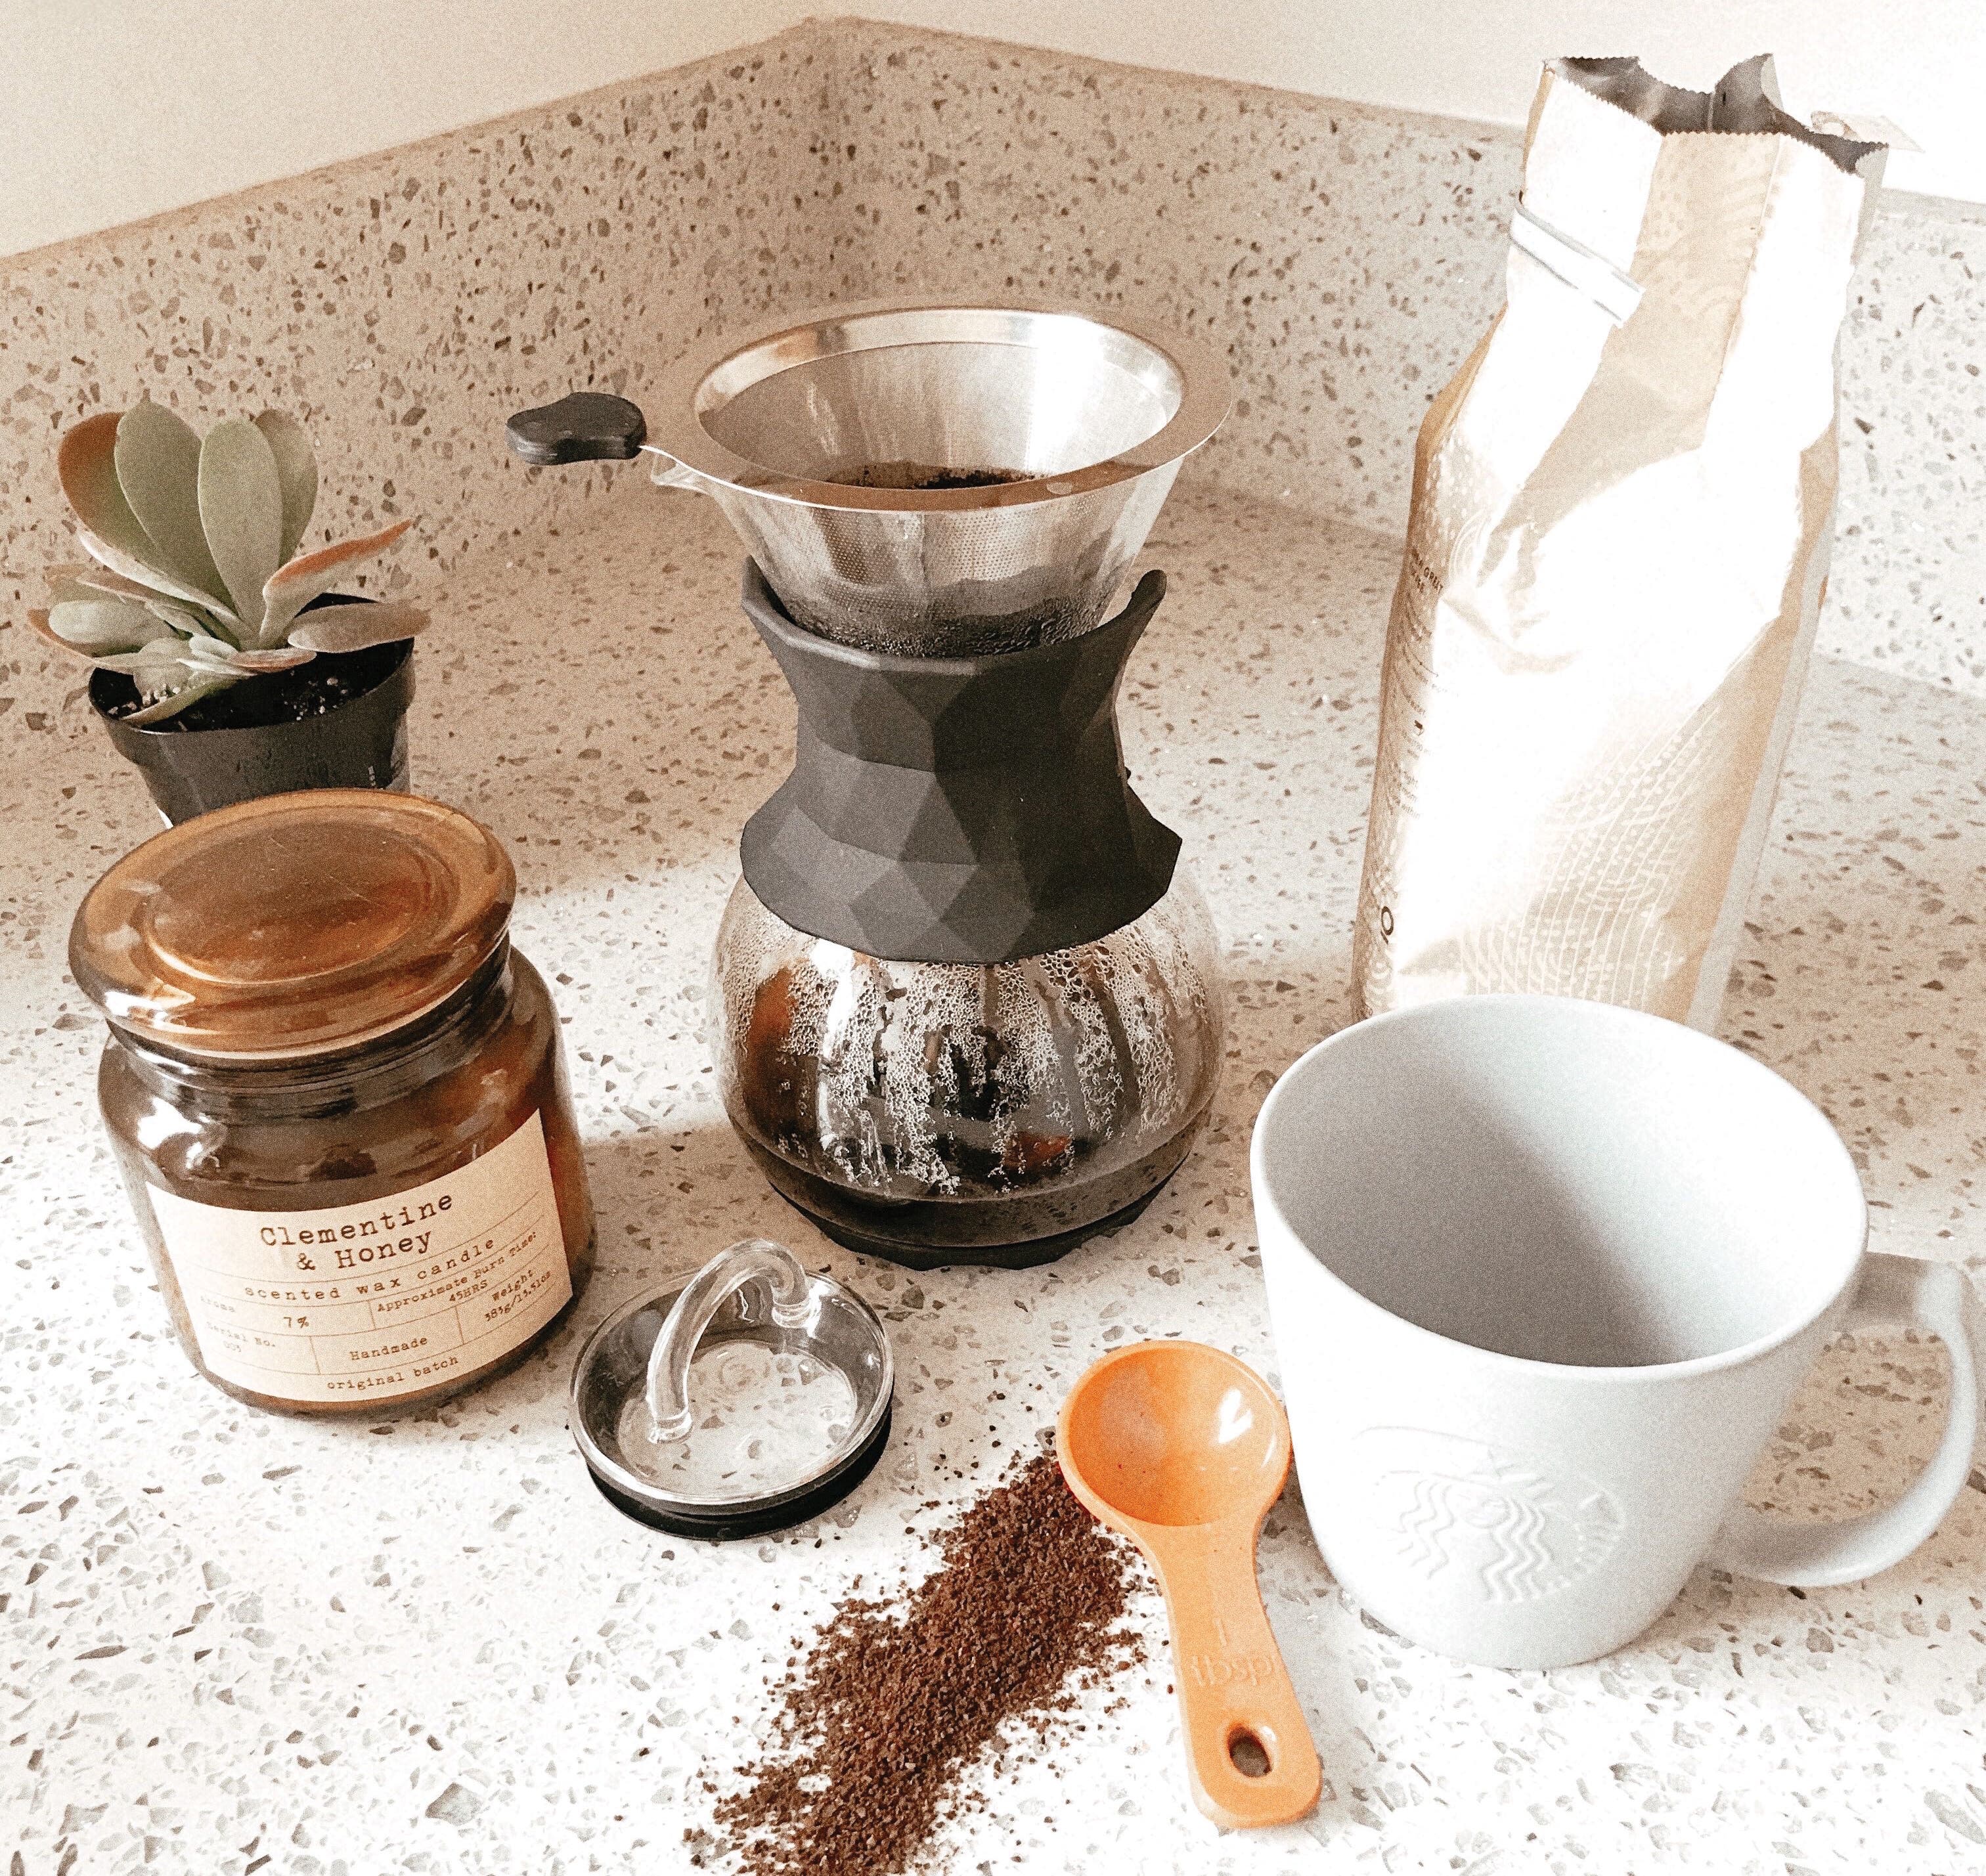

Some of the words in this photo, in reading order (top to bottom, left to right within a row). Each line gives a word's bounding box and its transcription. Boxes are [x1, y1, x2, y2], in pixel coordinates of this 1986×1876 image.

[260, 1194, 452, 1246] Clementine
[244, 1287, 341, 1300] scented
[356, 1278, 401, 1295] wax
[417, 1238, 494, 1280] candle
[296, 1252, 316, 1271] &
[334, 1231, 431, 1269] Honey
[378, 1276, 468, 1312] Approximate
[473, 1257, 505, 1278] Burn
[449, 1280, 488, 1301] 45HRS
[492, 1269, 535, 1301] Weight
[350, 1337, 428, 1361] Handmade
[327, 1372, 405, 1391] original
[413, 1356, 459, 1377] batch
